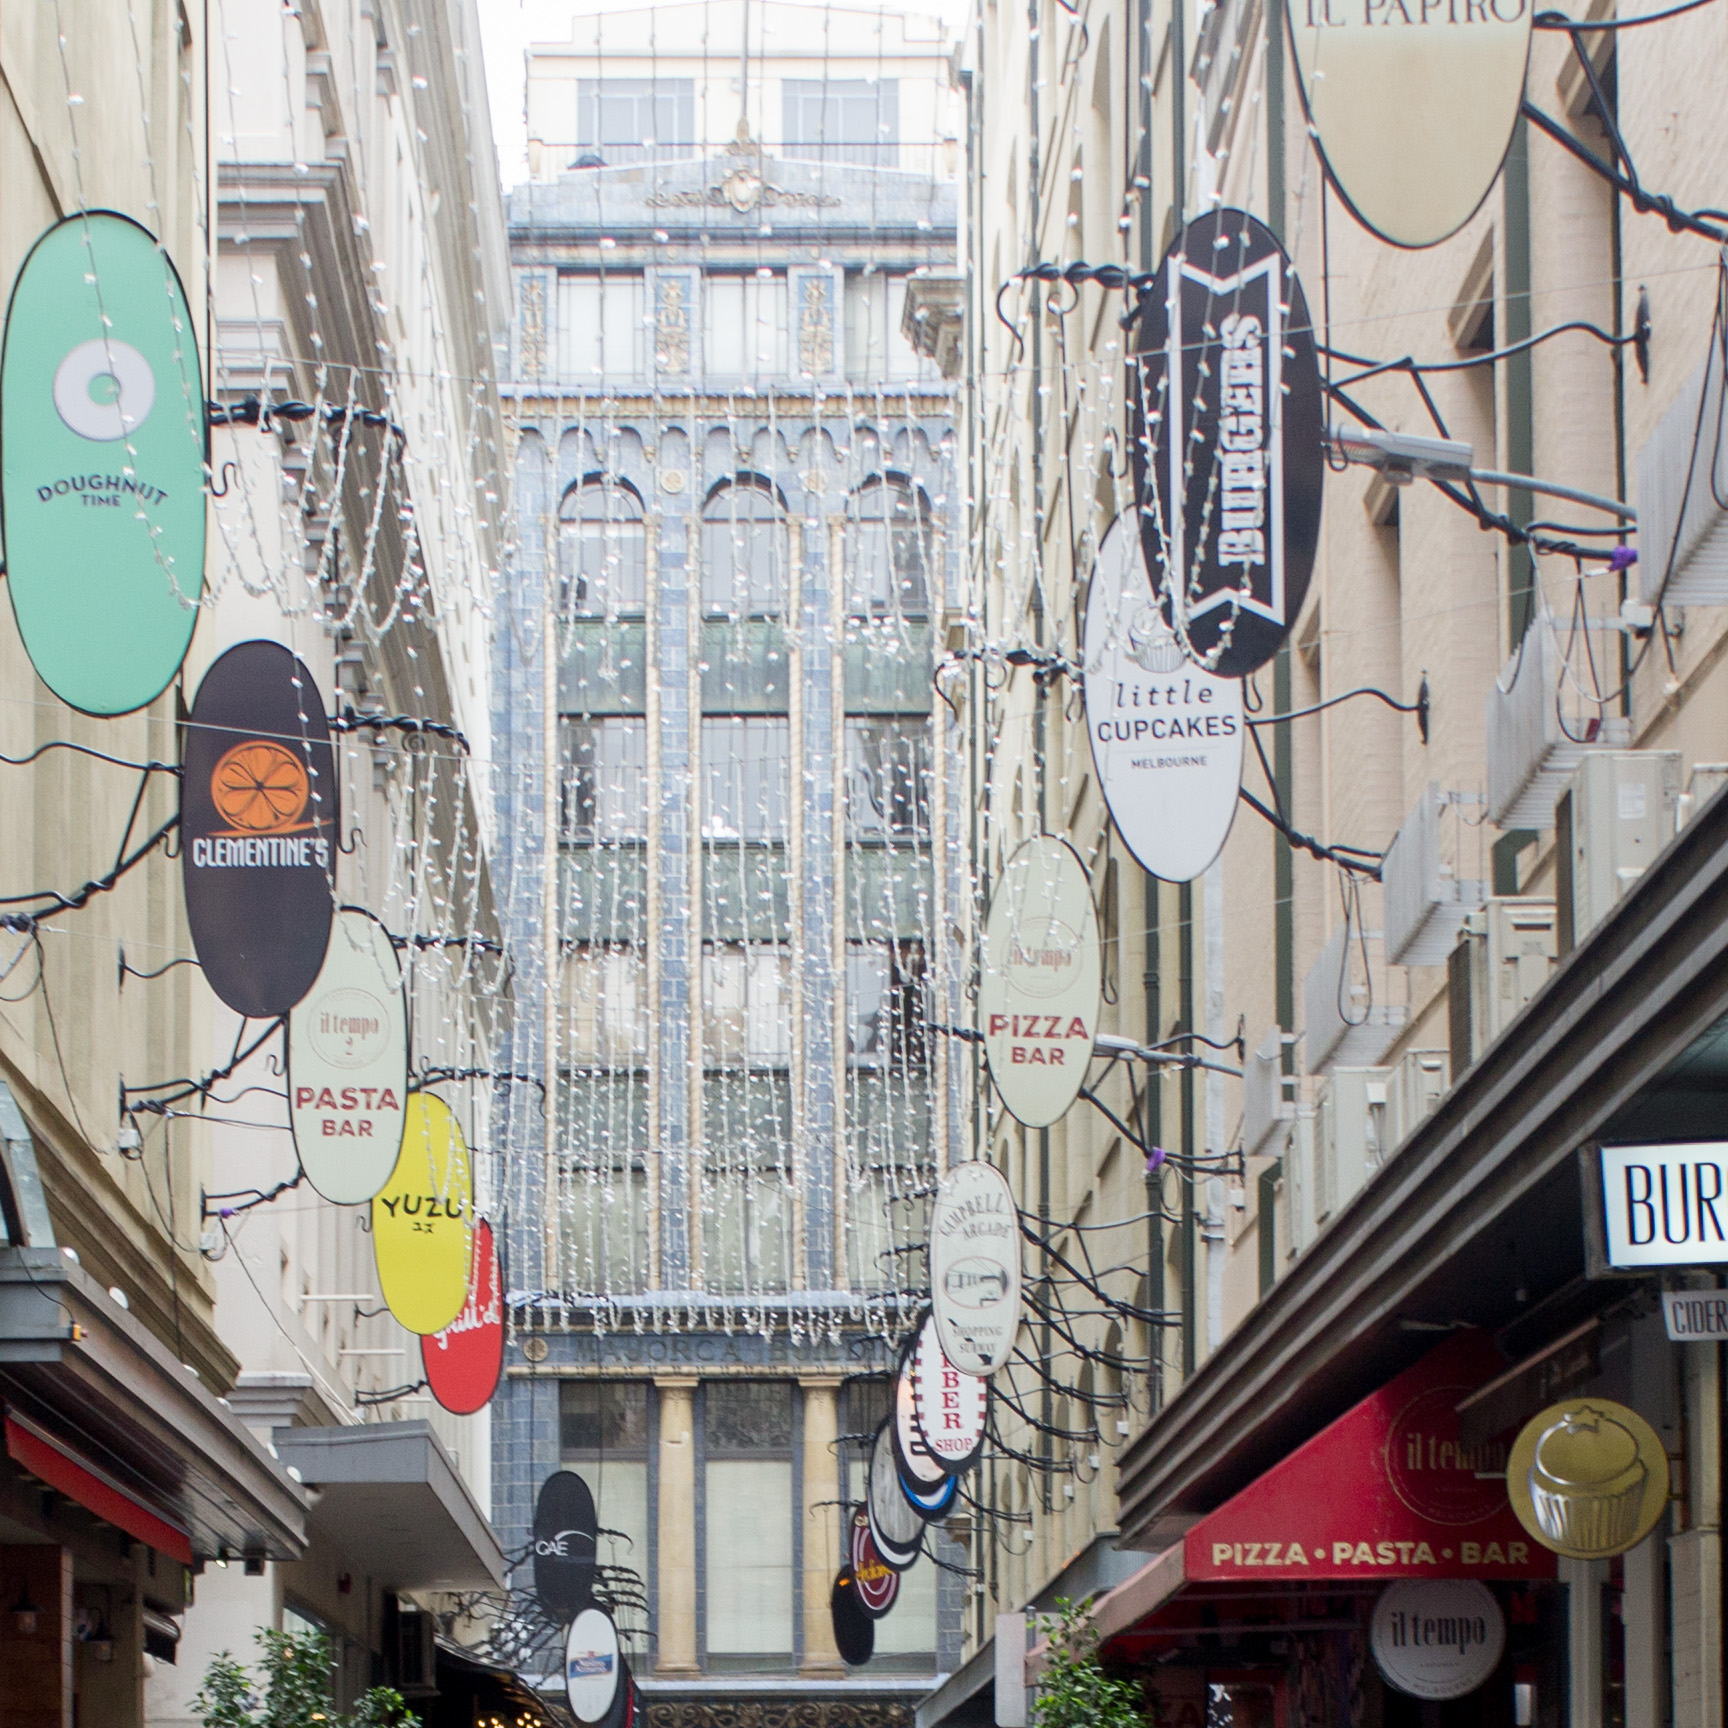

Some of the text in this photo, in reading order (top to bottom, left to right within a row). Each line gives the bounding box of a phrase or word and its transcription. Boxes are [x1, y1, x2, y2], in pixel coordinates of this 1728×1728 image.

[1305, 0, 1527, 28] IL PAPIRO
[1218, 314, 1265, 567] BURGERS
[36, 474, 168, 505] DOUGHNUT
[82, 494, 121, 507] TIME
[1117, 679, 1213, 708] little
[1097, 715, 1237, 742] CUPCAKES
[1131, 755, 1208, 769] MELBOURNE
[192, 837, 330, 868] CLEMENTINE'S
[320, 1012, 330, 1034] il
[989, 1014, 1089, 1039] PIZZA
[1011, 1046, 1065, 1065] BAR
[296, 1087, 400, 1111] PASTA
[322, 1119, 373, 1137] BAR
[381, 1194, 462, 1218] YUZU
[1672, 1300, 1728, 1334] CIDER
[935, 1438, 973, 1453] SHOP
[1407, 1433, 1422, 1470] il
[1212, 1541, 1529, 1566] PIZZA PASTA BAR
[1392, 1611, 1486, 1655] il tempo
